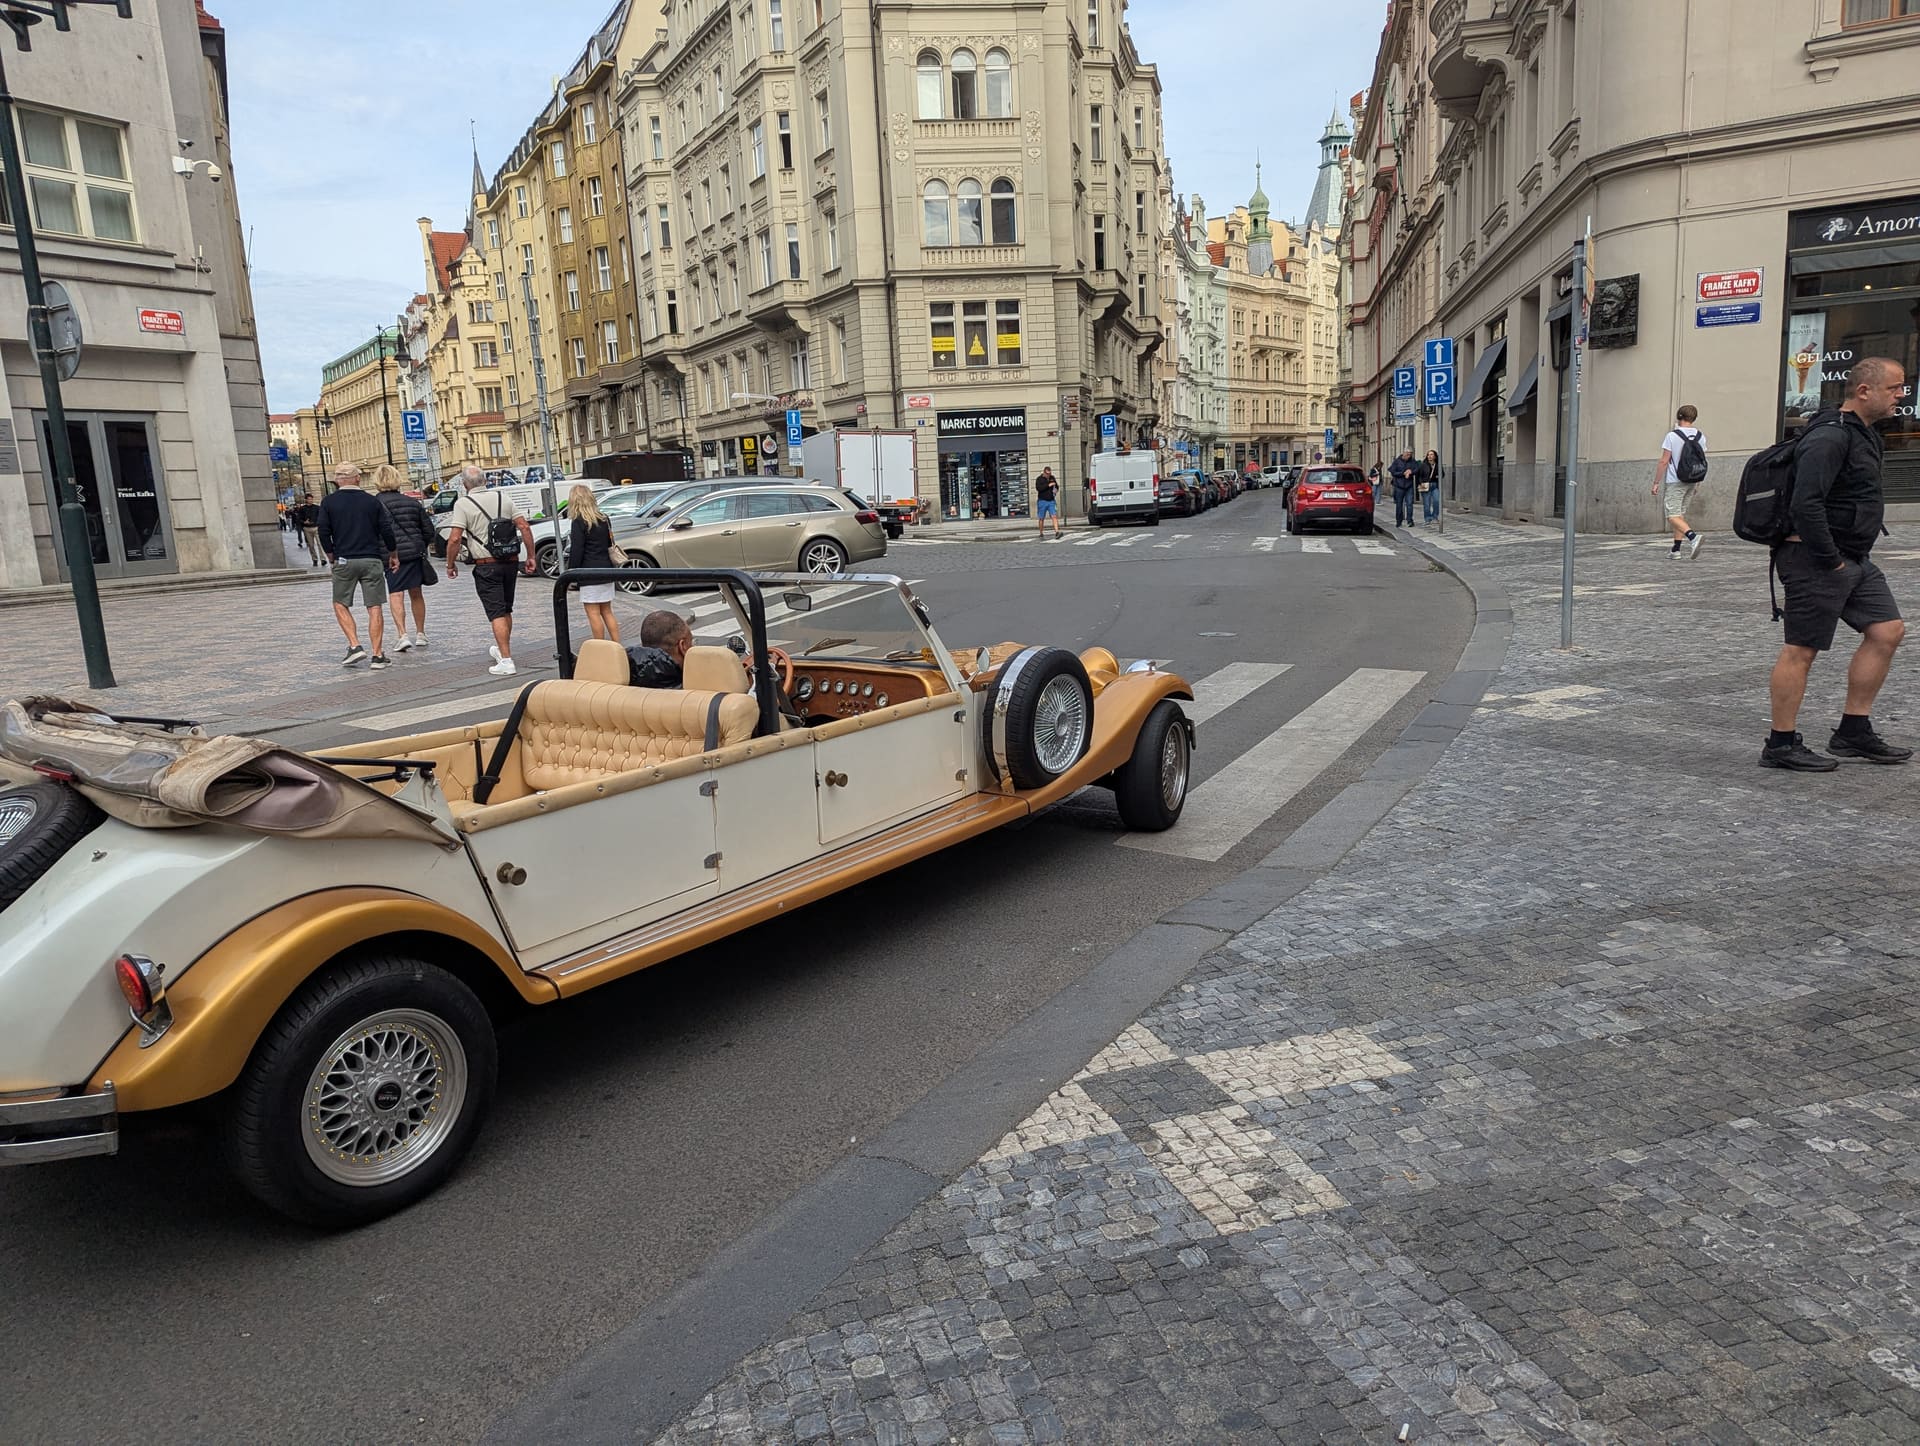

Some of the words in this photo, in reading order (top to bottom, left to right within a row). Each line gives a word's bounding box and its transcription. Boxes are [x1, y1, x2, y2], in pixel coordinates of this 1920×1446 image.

[1704, 280, 1732, 291] FRANZE
[1734, 278, 1756, 288] KAFKY
[143, 315, 163, 324] FRANZE
[1797, 350, 1853, 364] GELATO
[1398, 371, 1411, 389] P
[1820, 370, 1852, 382] MAC
[1431, 372, 1447, 394] P
[407, 415, 420, 431] P
[940, 417, 977, 430] MARKET
[979, 415, 1024, 428] SOUVENIR
[1104, 418, 1113, 430] P
[790, 428, 799, 440] P
